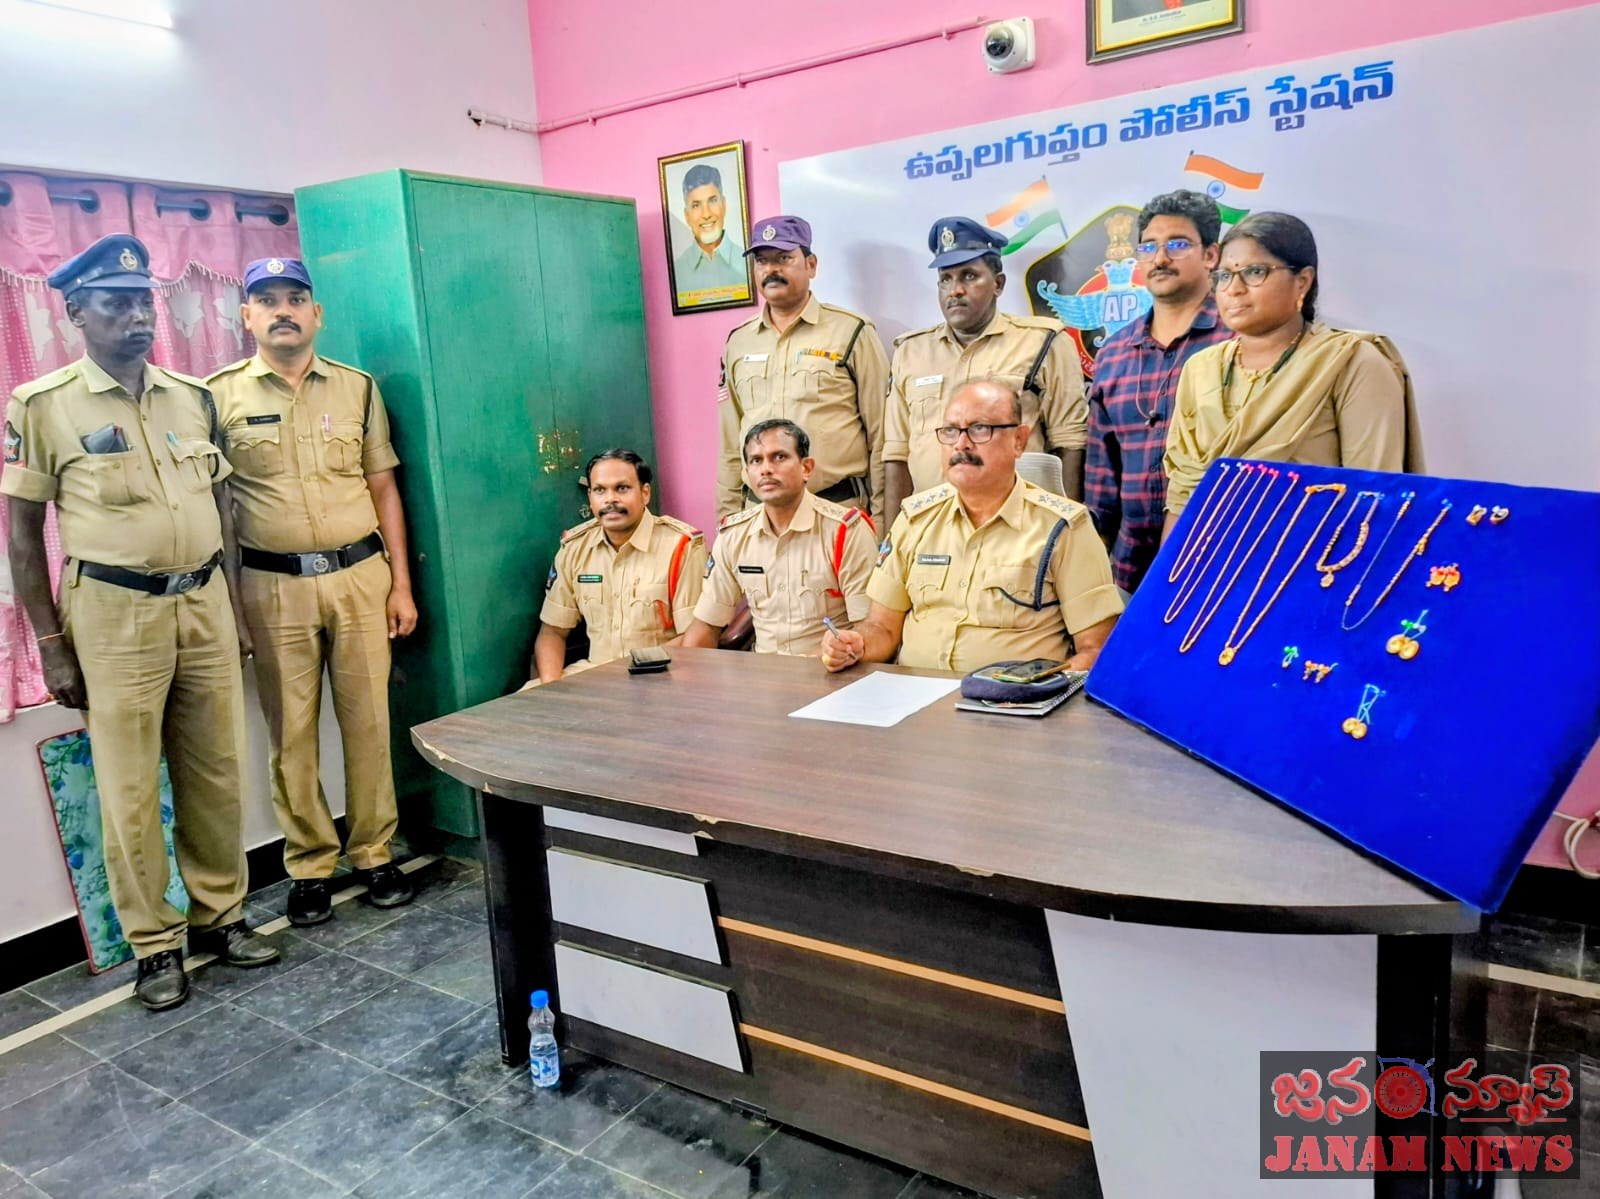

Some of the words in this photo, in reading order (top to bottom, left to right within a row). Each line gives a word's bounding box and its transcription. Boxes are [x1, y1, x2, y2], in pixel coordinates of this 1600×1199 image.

[904, 123, 1107, 181] ఉప్పలగుప్తం
[1120, 88, 1249, 142] పోలీస్
[1266, 60, 1394, 132] స్టేషన్
[1104, 294, 1138, 322] AP
